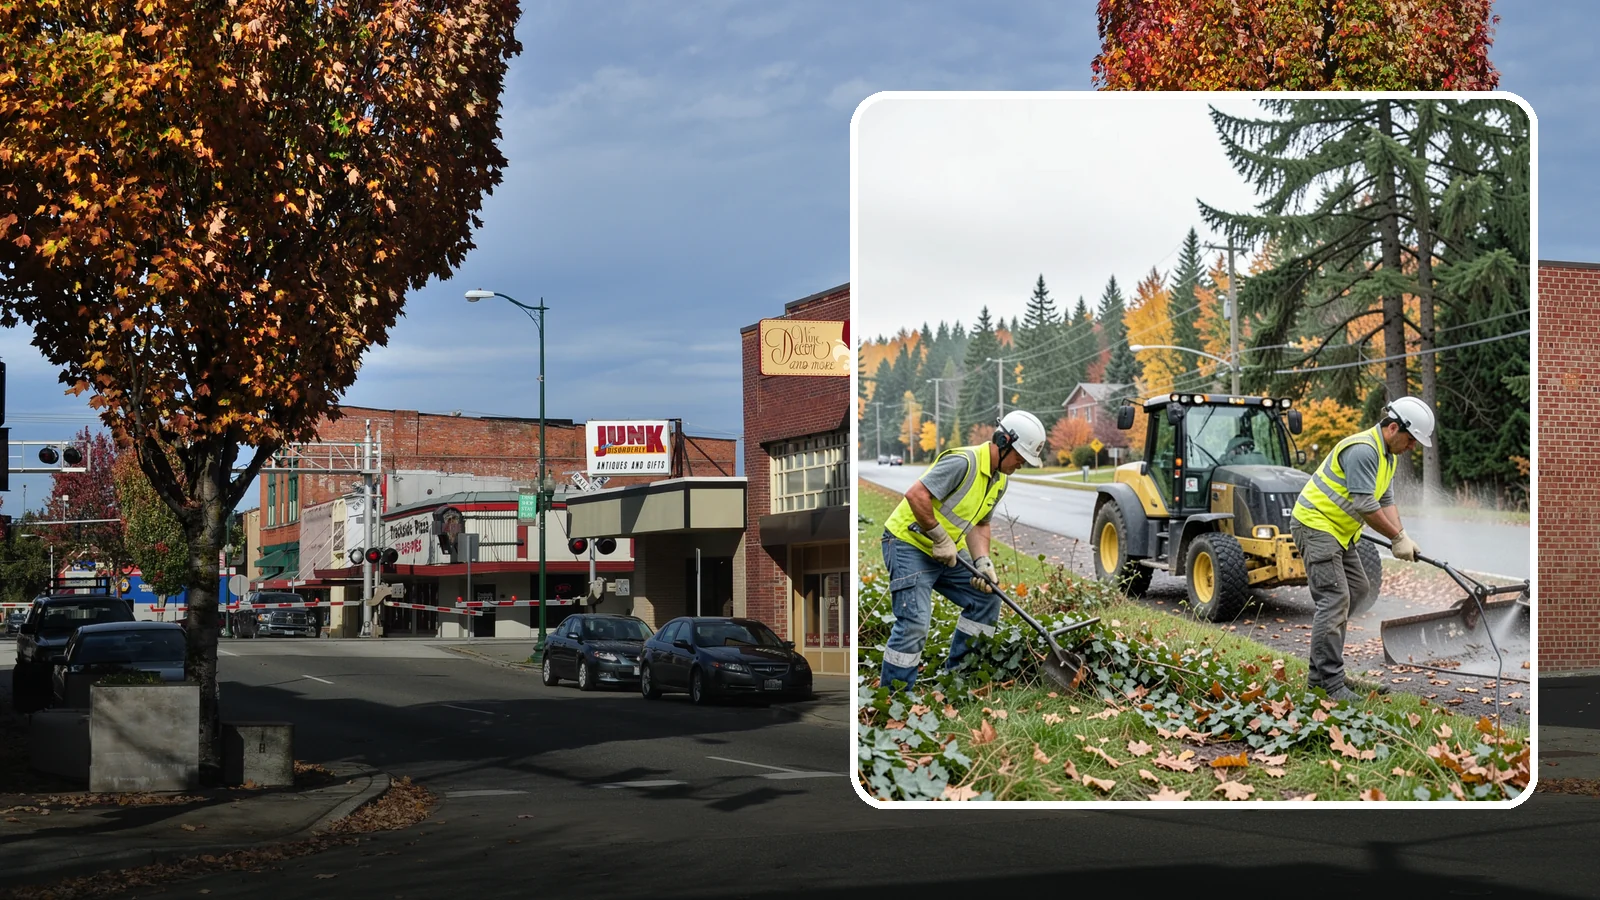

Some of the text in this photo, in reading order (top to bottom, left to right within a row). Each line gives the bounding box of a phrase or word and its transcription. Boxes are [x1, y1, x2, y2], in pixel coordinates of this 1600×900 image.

[595, 425, 665, 457] JUNK
[607, 446, 646, 454] DISORDERLY
[596, 460, 665, 470] ANTIQUES AND GIFTS
[573, 473, 589, 491] RAIL
[589, 476, 608, 492] SING
[352, 498, 365, 511] CRO
[390, 519, 429, 540] Trackside Pizza
